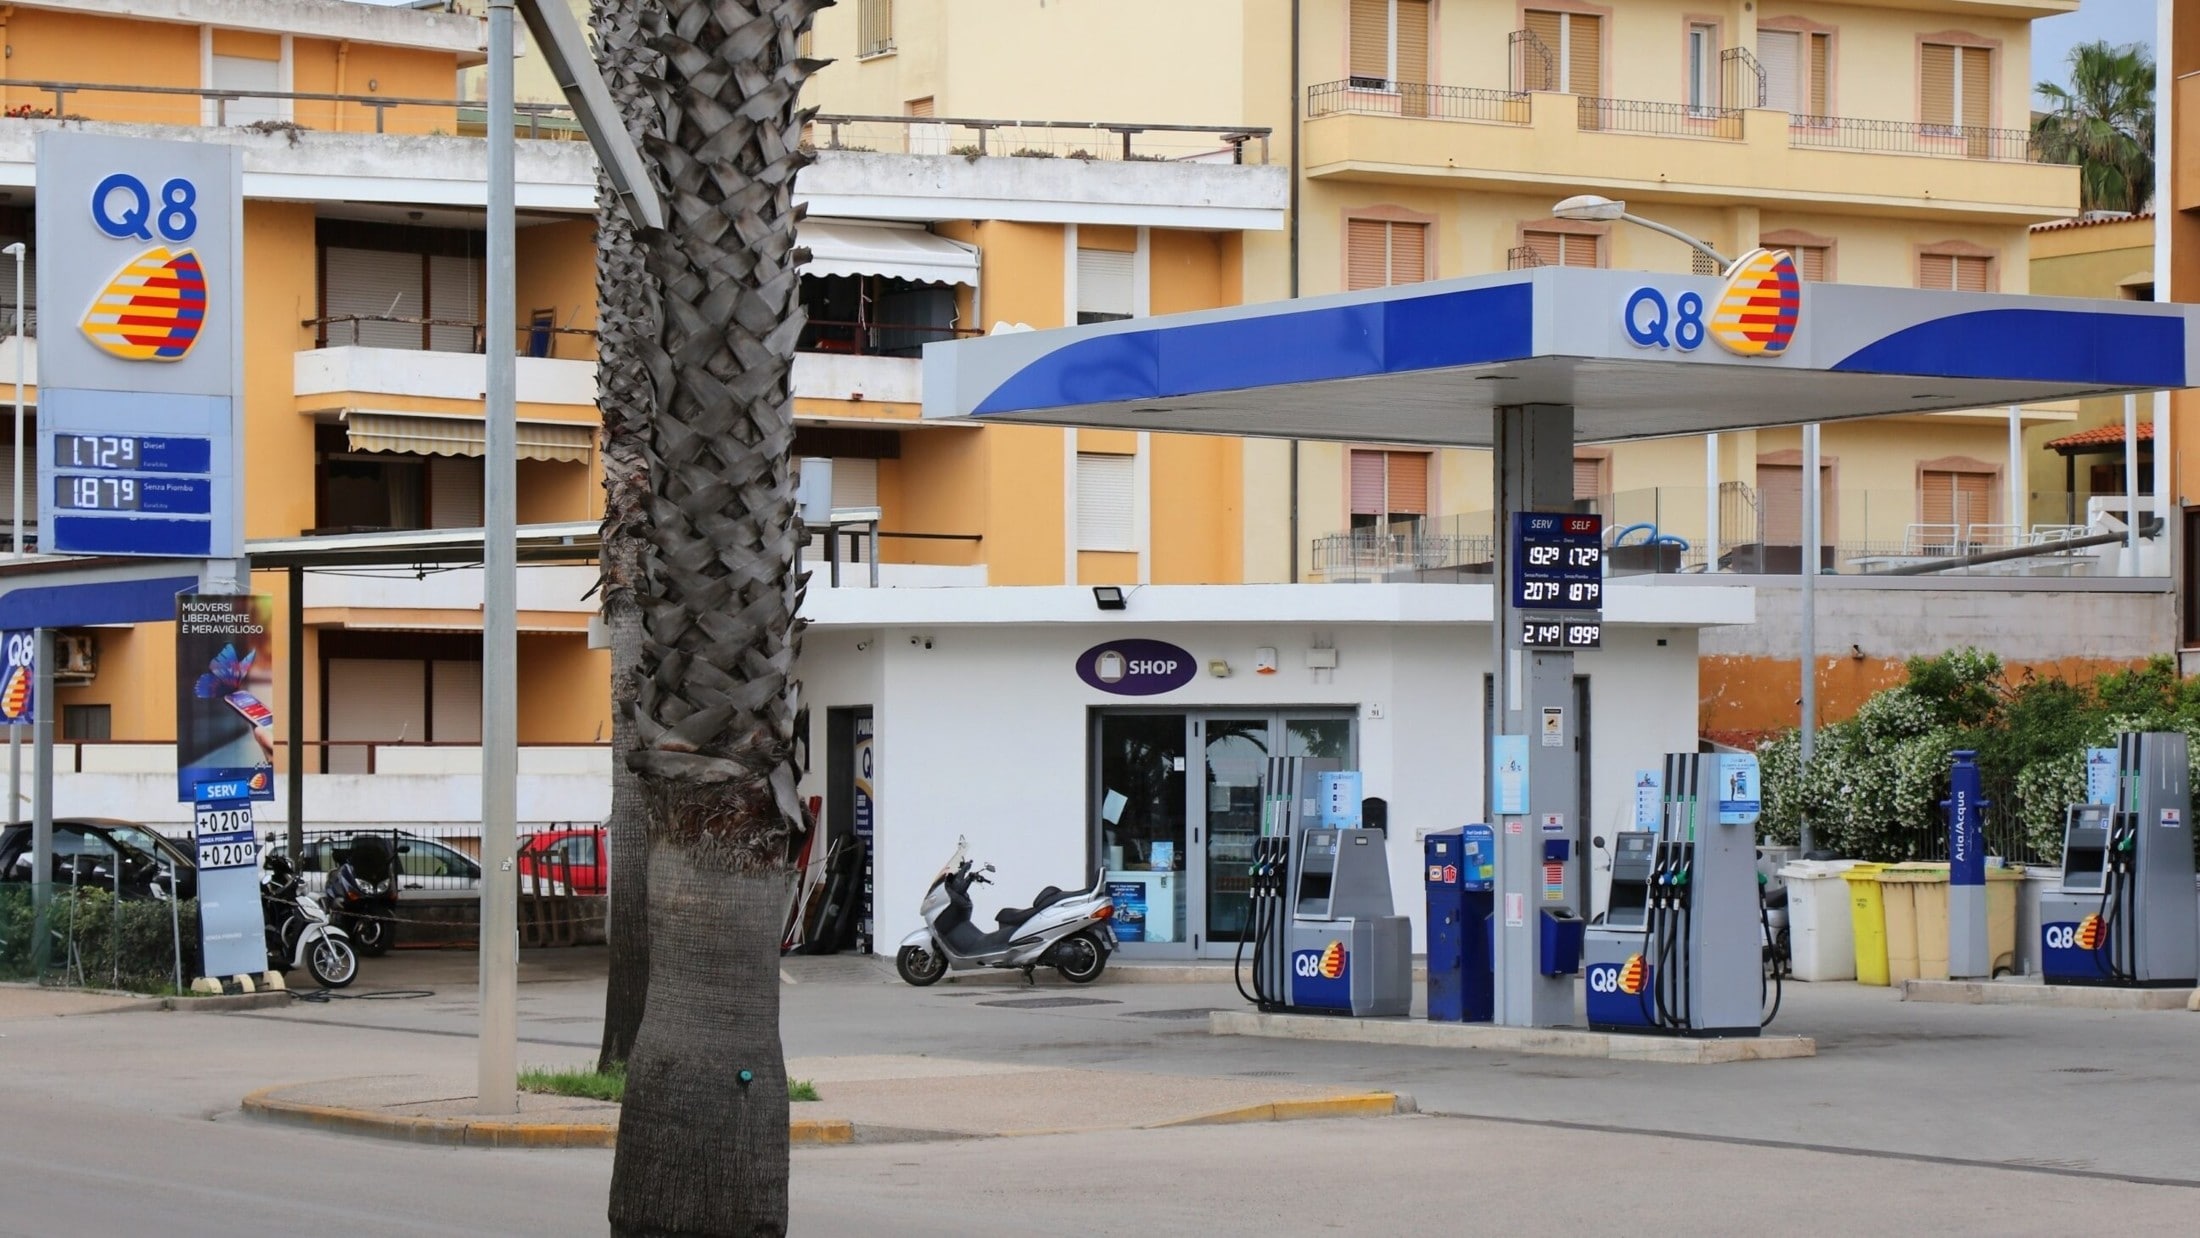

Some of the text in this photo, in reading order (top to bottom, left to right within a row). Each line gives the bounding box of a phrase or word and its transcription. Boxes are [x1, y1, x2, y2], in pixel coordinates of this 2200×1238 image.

[92, 173, 197, 241] Q8
[1624, 286, 1704, 350] Q8
[143, 441, 166, 450] Diesel
[143, 482, 194, 492] Senza Piombo
[1531, 519, 1553, 529] SERV
[1571, 520, 1591, 530] SELF
[182, 603, 232, 612] MUOVERSI
[182, 614, 250, 623] LIBERAMENTE
[182, 623, 264, 634] È MERAVIGLIOSO
[8, 633, 34, 667] Q8
[1129, 660, 1178, 675] SHOP
[207, 784, 237, 799] SERV
[1955, 790, 1967, 862] Aria/Acqua
[2046, 925, 2074, 948] Q8
[1295, 953, 1319, 977] Q8
[1590, 967, 1617, 993] Q8
